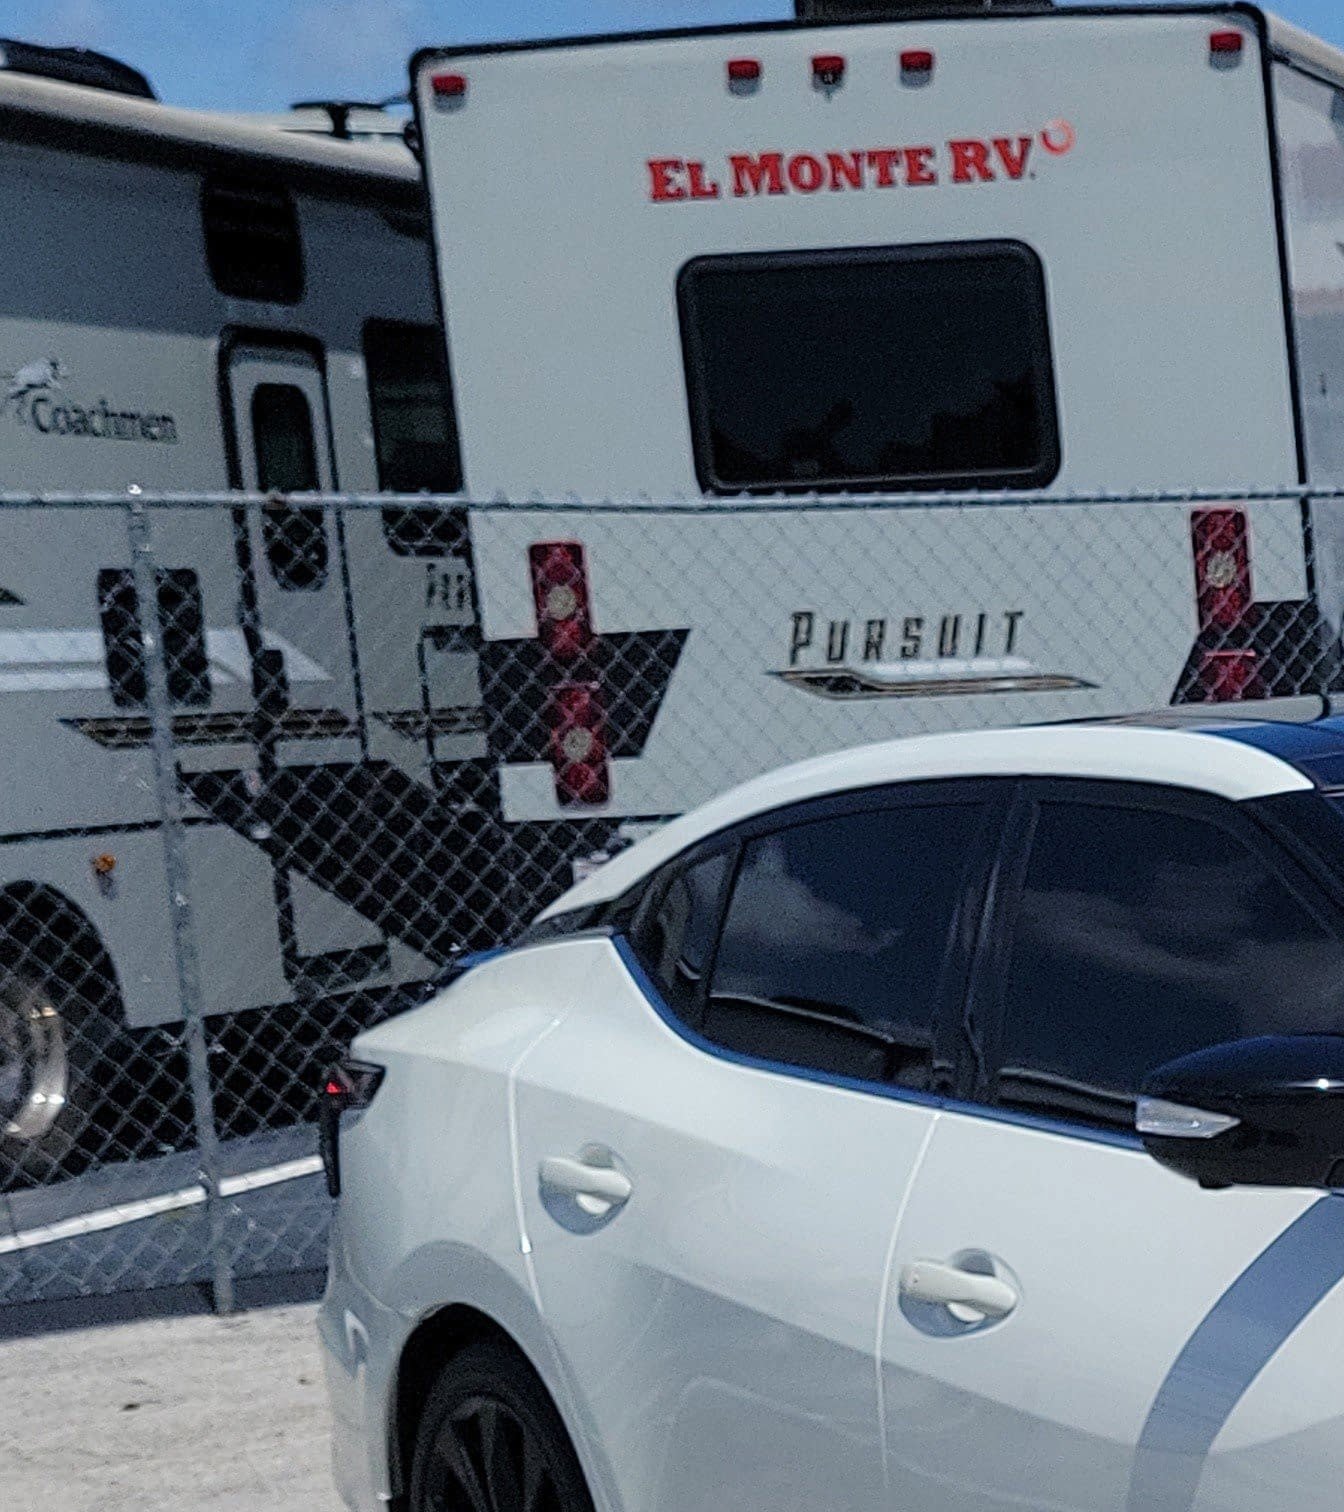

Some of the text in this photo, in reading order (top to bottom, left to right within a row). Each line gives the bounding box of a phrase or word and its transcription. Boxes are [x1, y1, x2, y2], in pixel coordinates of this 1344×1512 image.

[646, 137, 1031, 202] EL MONTE RV
[31, 397, 178, 445] Coachmen
[789, 610, 1025, 666] PURSUIT
